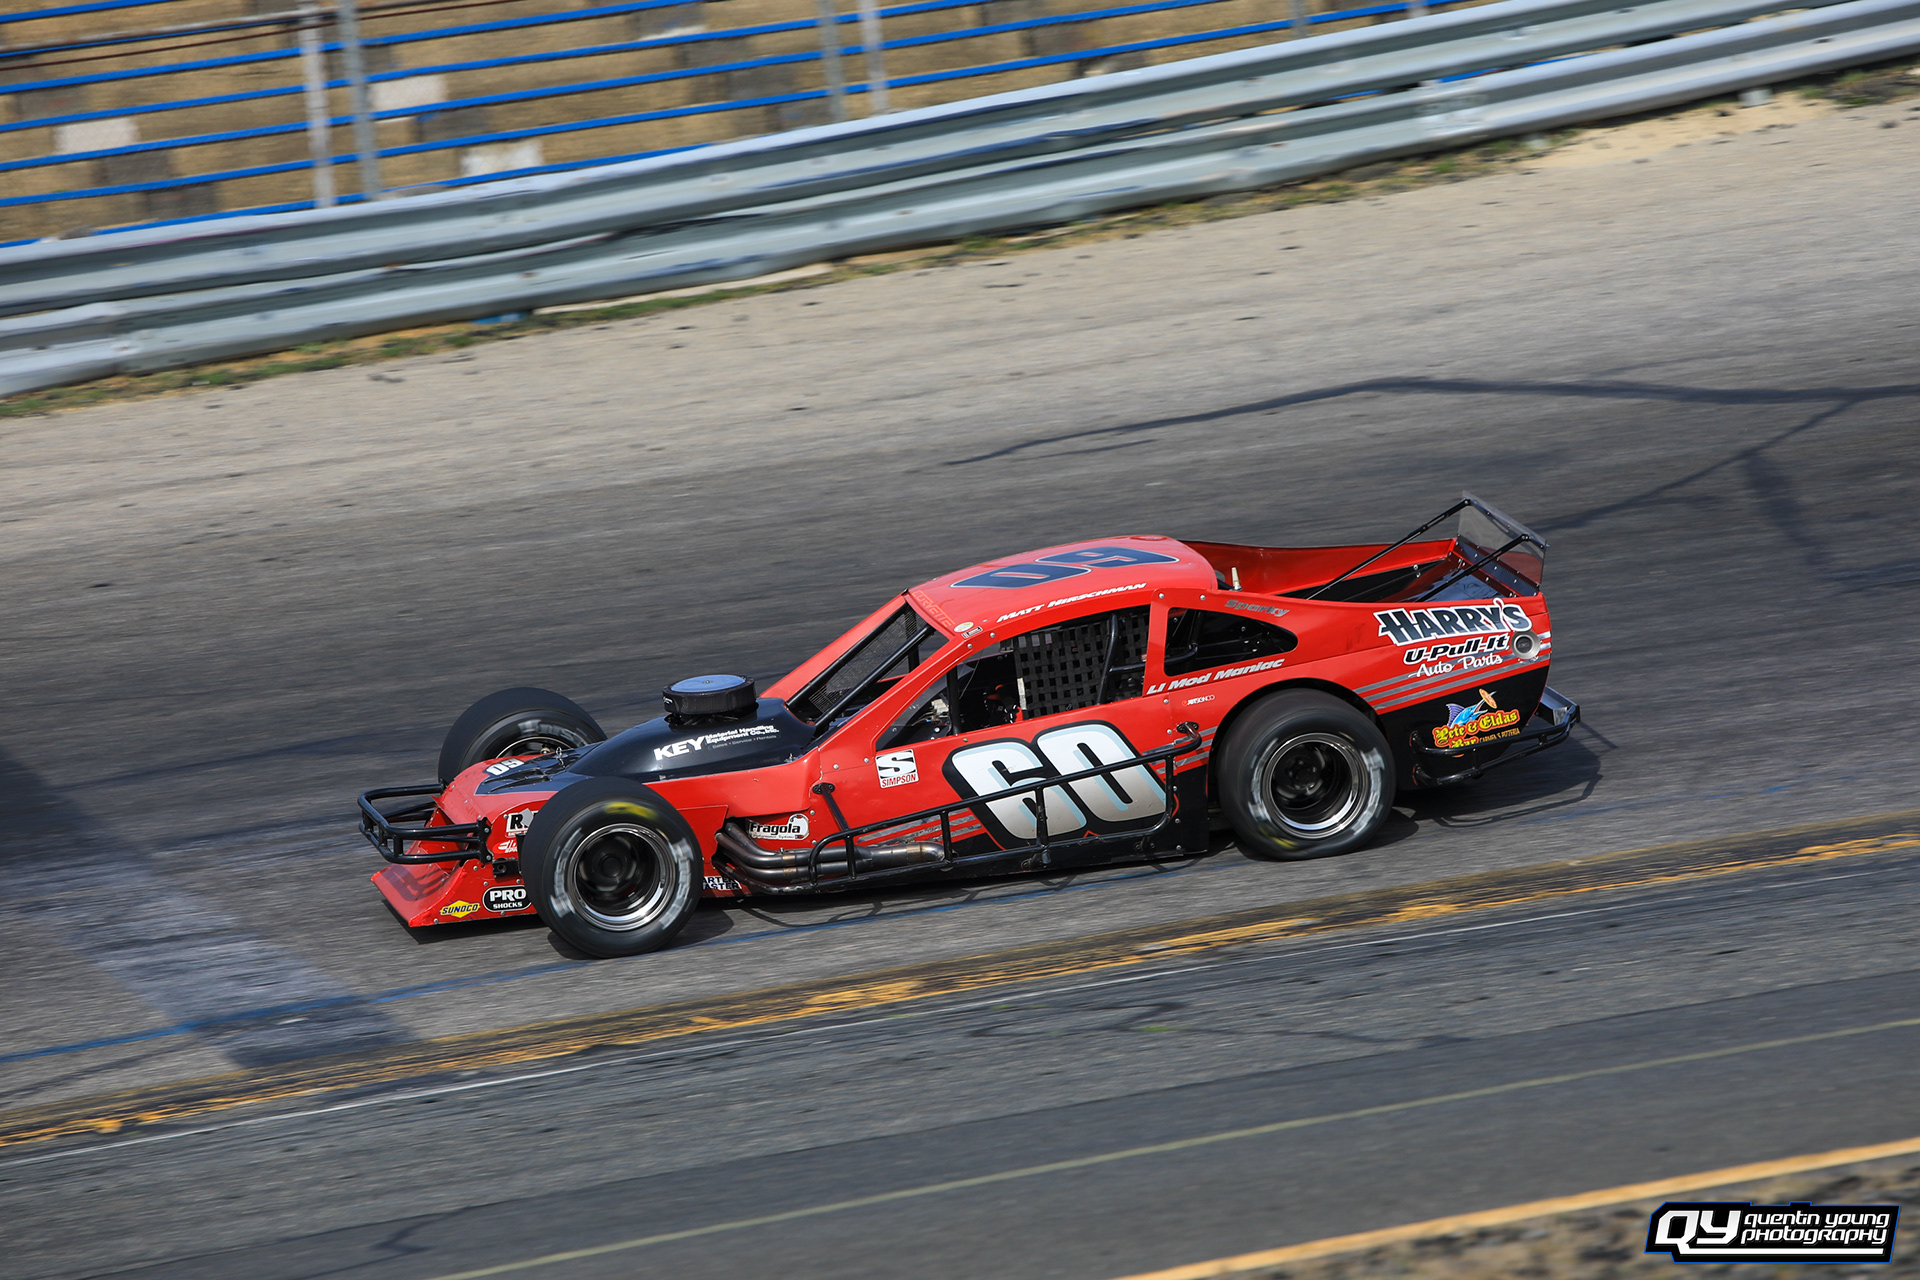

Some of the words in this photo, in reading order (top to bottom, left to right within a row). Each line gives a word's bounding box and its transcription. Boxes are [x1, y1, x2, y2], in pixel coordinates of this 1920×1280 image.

[997, 604, 1045, 623] MATT
[1047, 583, 1147, 608] HIRSCHMAN
[1225, 600, 1290, 617] Sparky
[1374, 598, 1532, 645] HARRY'S
[1408, 663, 1454, 678] Auto
[1458, 653, 1503, 670] Parts
[1146, 683, 1166, 695] LI
[1168, 673, 1212, 690] Mod
[1213, 658, 1286, 681] Maniac
[706, 729, 738, 739] Material
[739, 725, 775, 733] Handling
[1434, 726, 1465, 745] Pete
[1467, 721, 1478, 733] &
[1479, 711, 1518, 730] Eldas
[706, 733, 749, 744] Equipment
[653, 736, 706, 761] KEY
[881, 774, 917, 788] SIMPSON
[951, 724, 1167, 840] 60
[750, 822, 801, 836] Fragola
[489, 889, 527, 902] PRO
[441, 903, 479, 916] SUNOCO
[492, 901, 523, 910] SHOCKS
